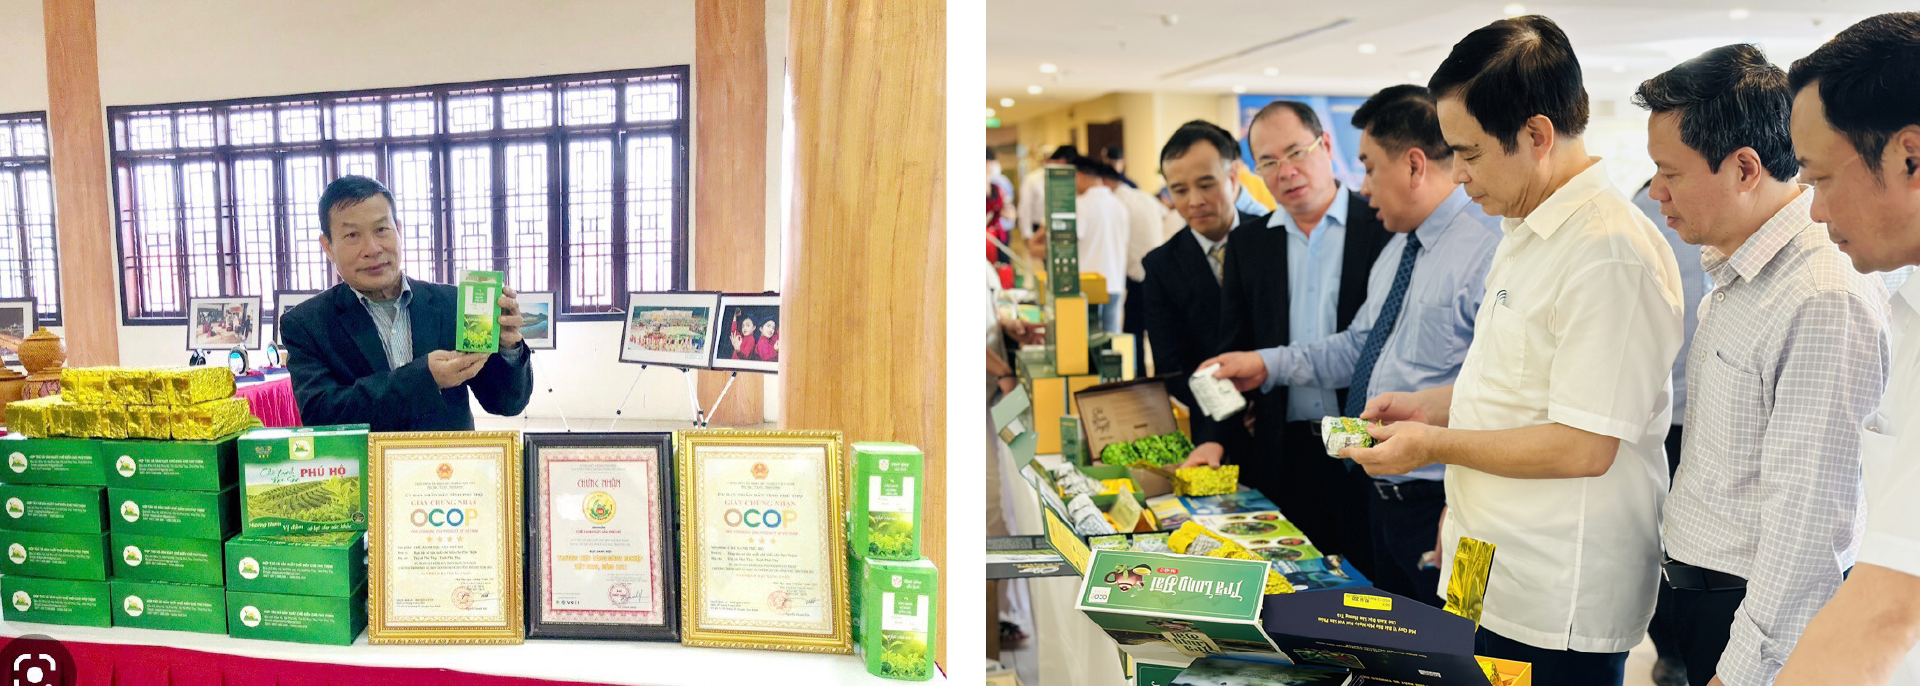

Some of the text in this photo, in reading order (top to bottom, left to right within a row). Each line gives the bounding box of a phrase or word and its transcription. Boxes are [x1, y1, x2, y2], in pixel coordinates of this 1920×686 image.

[300, 465, 325, 477] PHÚ
[329, 464, 346, 479] HỘ
[410, 508, 478, 527] OCOP
[724, 509, 798, 528] OCOP
[1178, 576, 1214, 599] Long
